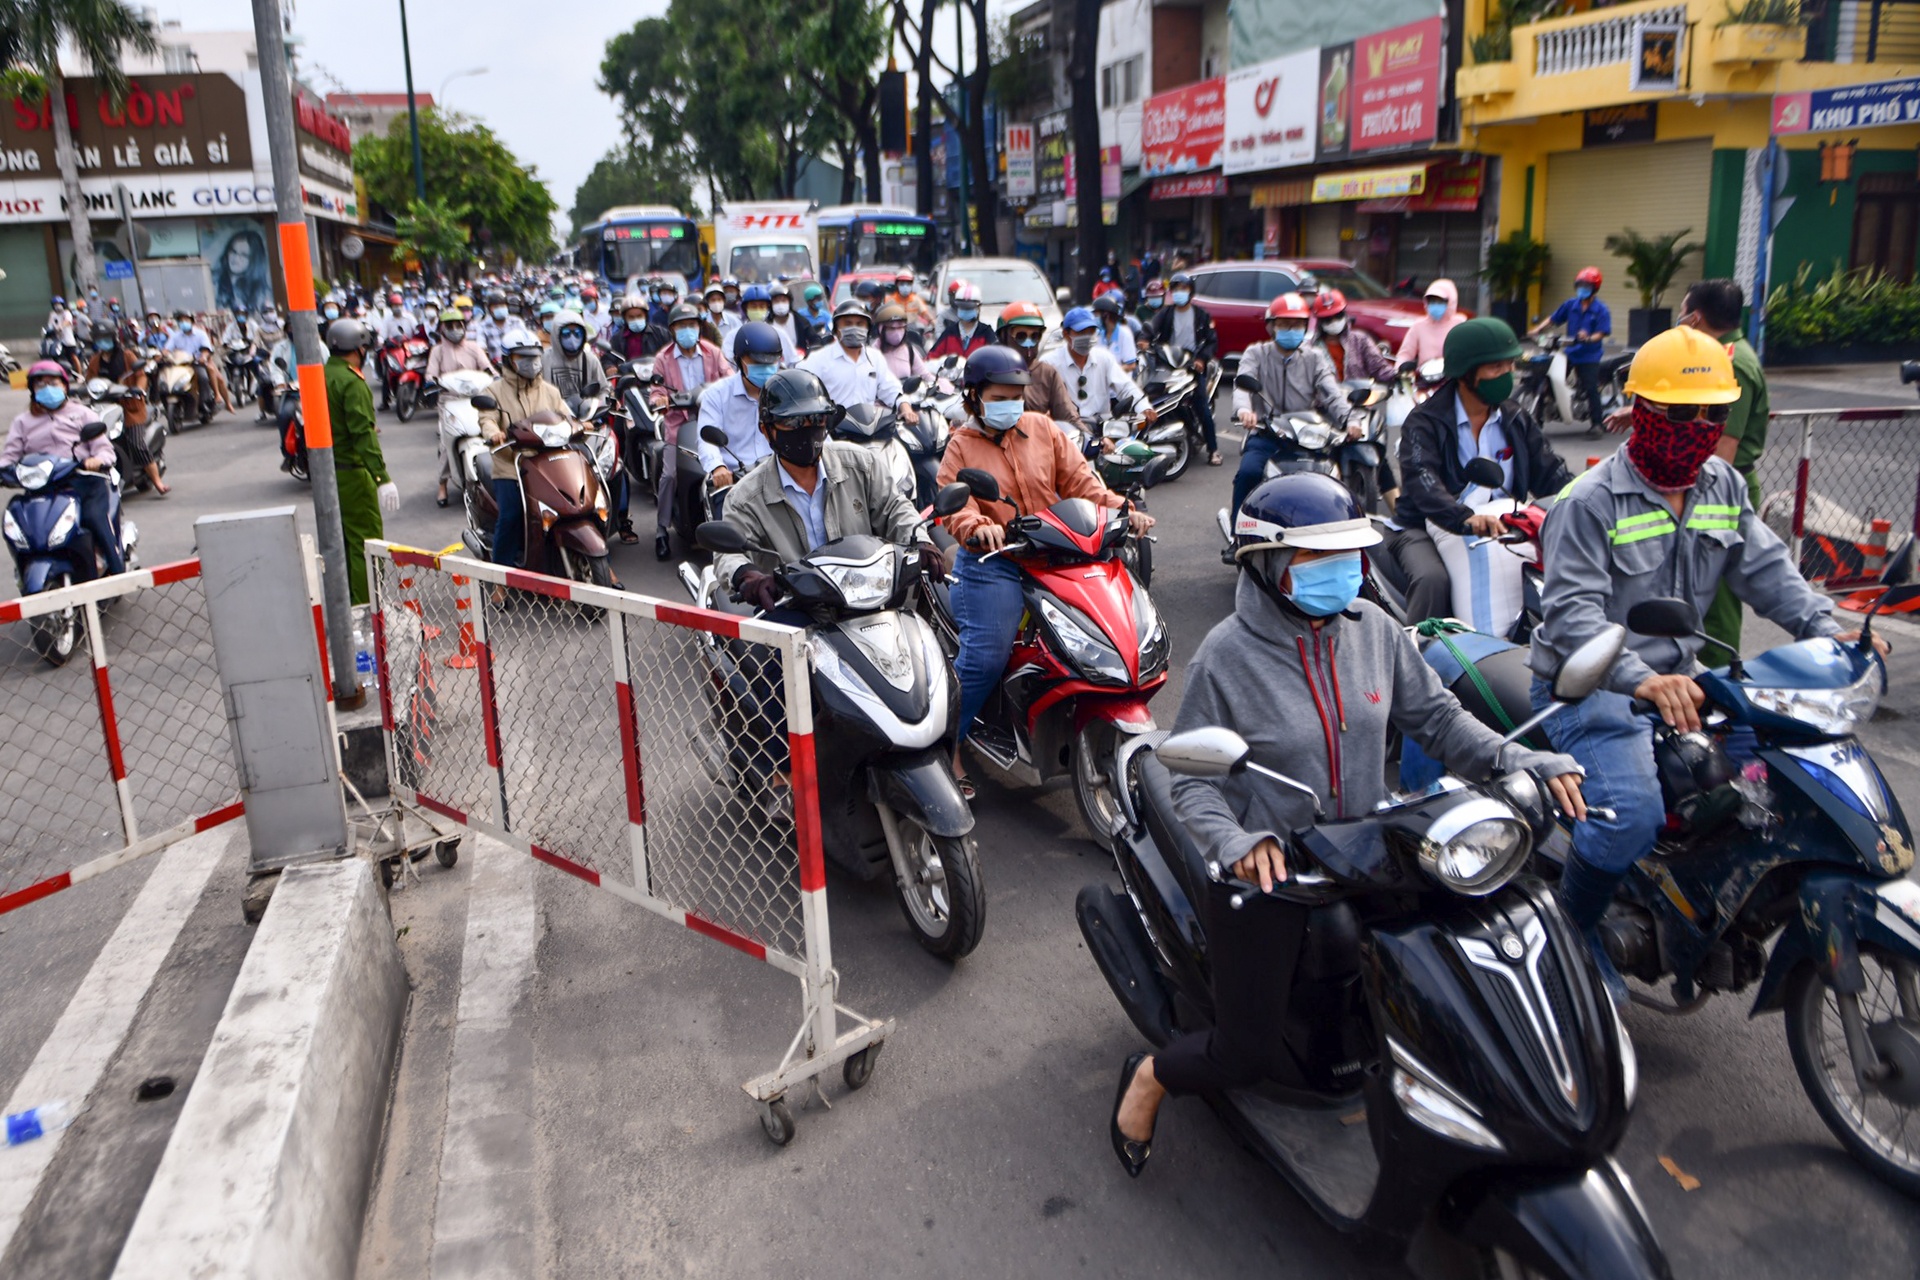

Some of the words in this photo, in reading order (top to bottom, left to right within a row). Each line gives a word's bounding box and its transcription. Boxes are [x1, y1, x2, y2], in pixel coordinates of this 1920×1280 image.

[1812, 105, 1854, 131] KHU
[1857, 95, 1901, 125] PHỐ
[1905, 98, 1920, 119] V
[1009, 127, 1030, 152] IN
[154, 137, 194, 166] GIÁ
[193, 186, 275, 206] GUCC
[745, 214, 805, 230] HTL
[1331, 1060, 1362, 1076] YAMAHA
